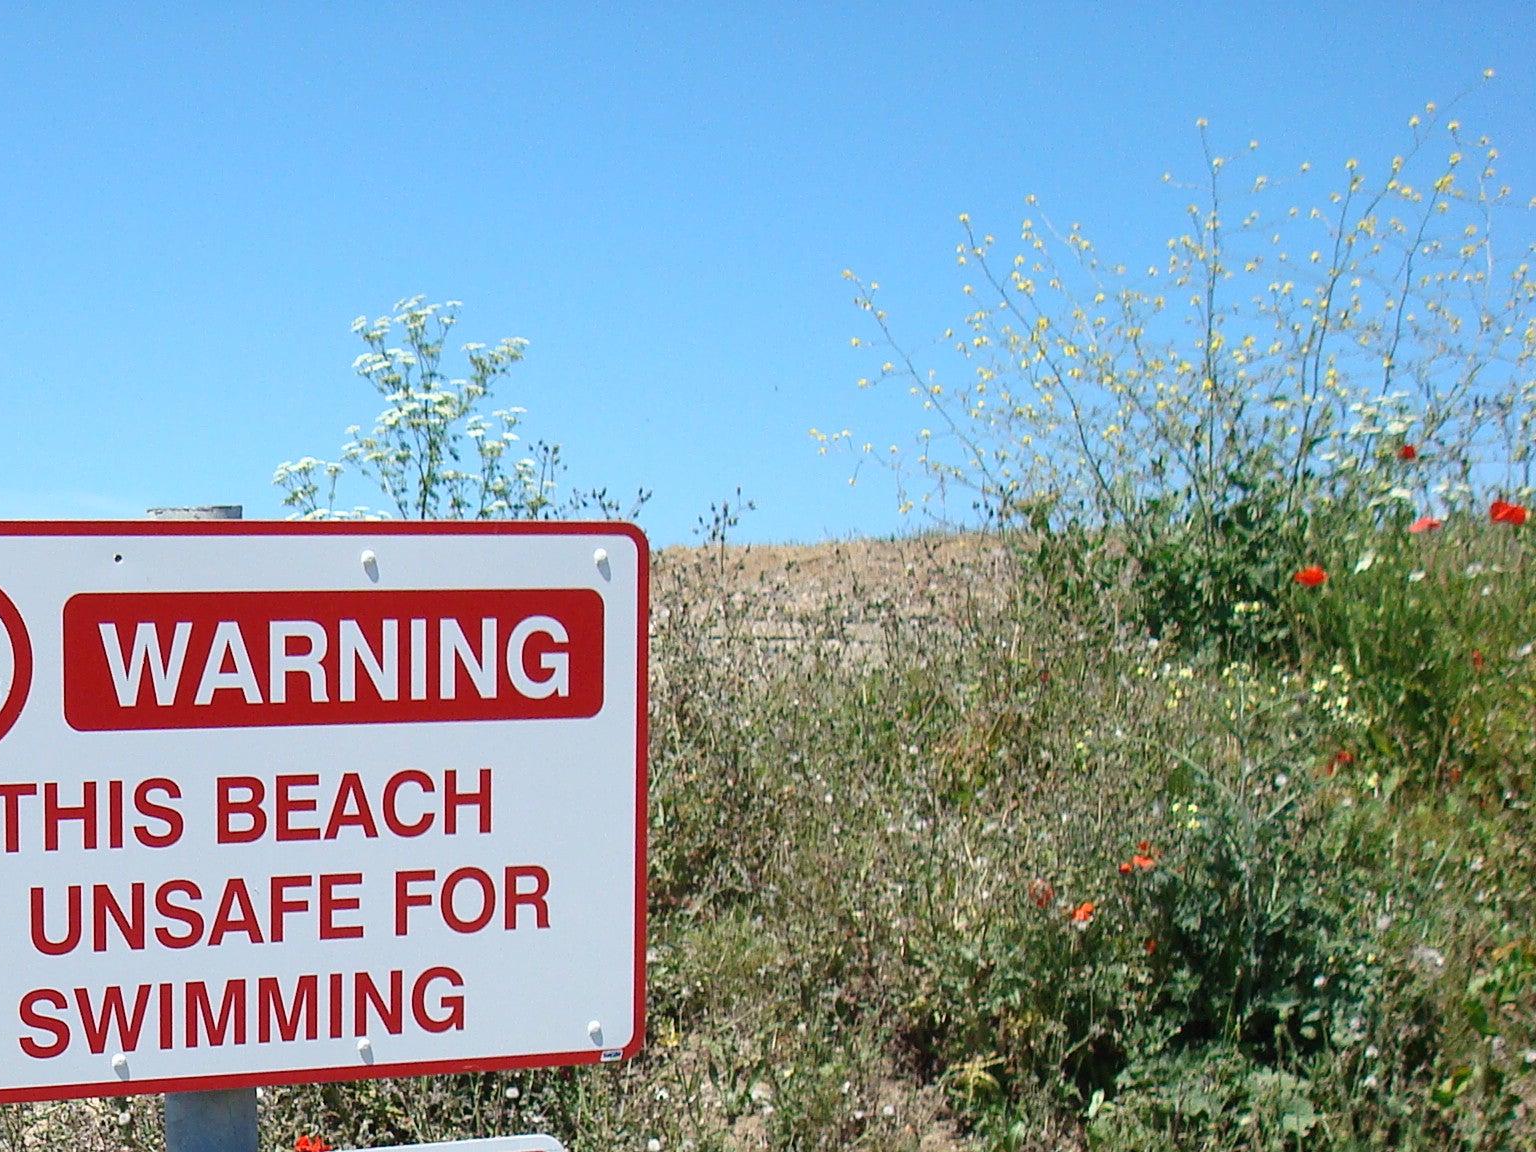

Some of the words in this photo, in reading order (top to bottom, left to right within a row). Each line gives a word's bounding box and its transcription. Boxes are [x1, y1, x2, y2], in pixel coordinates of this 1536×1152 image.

[98, 616, 570, 707] WARNING
[217, 768, 492, 845] BEACH
[30, 872, 364, 955] UNSAFE
[395, 865, 551, 937] FOR
[19, 966, 464, 1059] SWIMMING
